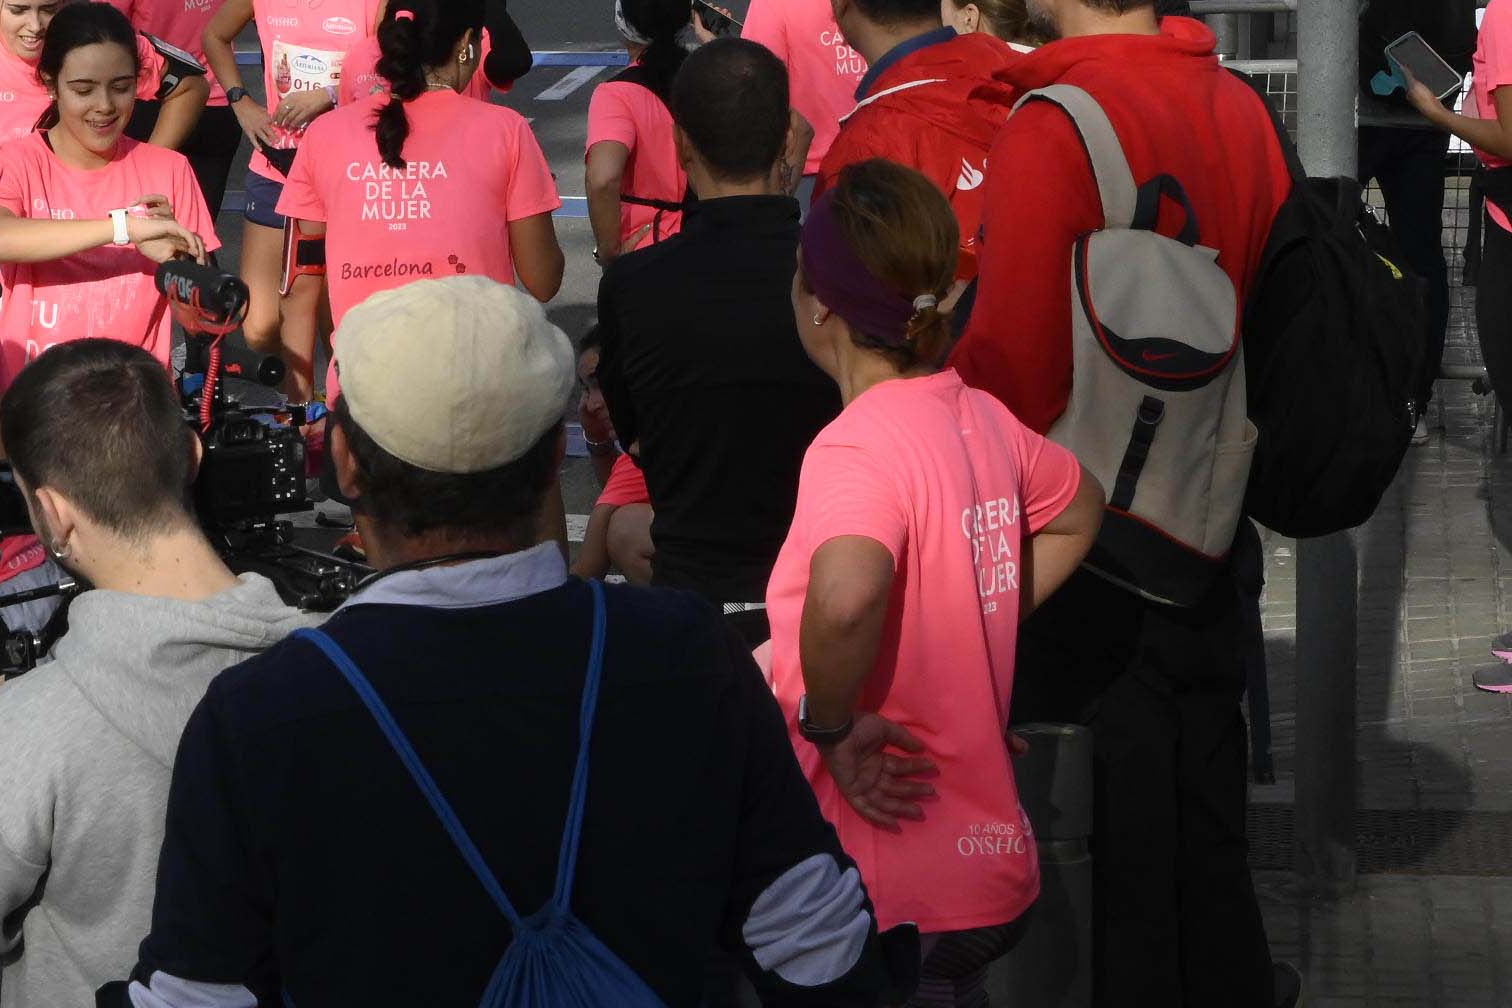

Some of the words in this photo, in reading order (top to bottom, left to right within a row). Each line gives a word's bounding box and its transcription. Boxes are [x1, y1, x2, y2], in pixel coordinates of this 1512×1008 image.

[347, 160, 447, 181] CARRERA
[366, 181, 391, 199] DE
[401, 180, 426, 198] LA
[362, 200, 431, 220] MUJER
[341, 258, 433, 280] Barcelona
[980, 561, 1018, 598] UJER
[982, 822, 1015, 835] AÑOS
